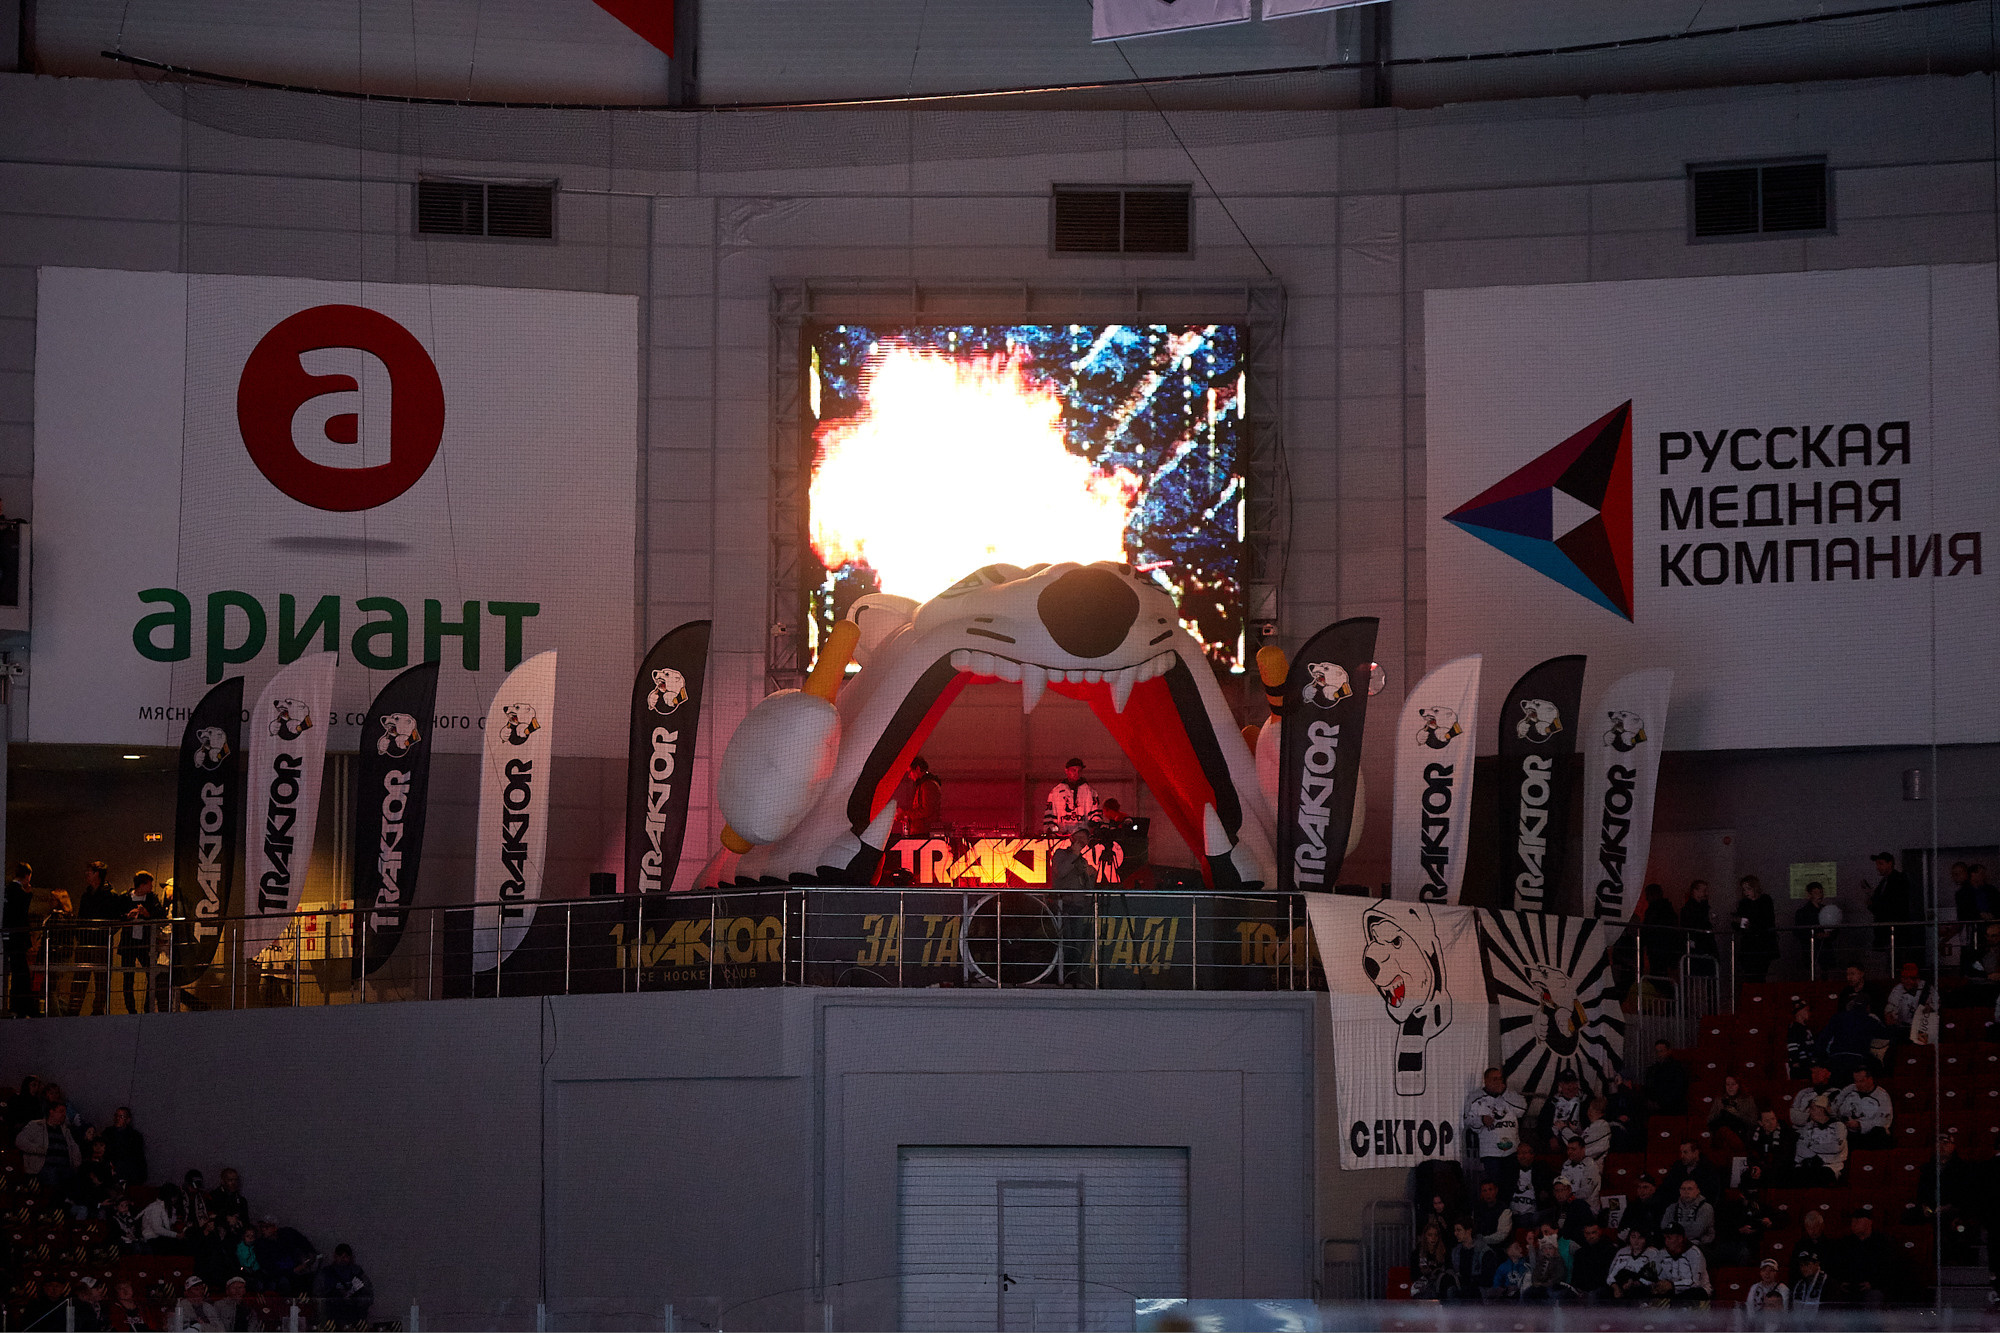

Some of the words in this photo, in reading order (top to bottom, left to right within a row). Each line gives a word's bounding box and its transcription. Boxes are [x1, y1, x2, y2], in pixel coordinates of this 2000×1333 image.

[1660, 421, 1911, 475] РУССКАЯ
[1660, 478, 1901, 531] МЕДНАЯ
[132, 588, 541, 685] ариант
[1660, 532, 1983, 587] КОМПАНИЯ
[193, 781, 225, 944] TRAKTOR
[258, 753, 303, 914] TRAKTOR
[369, 769, 412, 935] TRAKTOR
[499, 758, 533, 925] TRAKTOR
[639, 726, 679, 893] TRAKTOR
[1293, 720, 1341, 889] TRAKTOR
[1419, 762, 1454, 905] RAKTOR
[1513, 754, 1553, 912] TRAKTOR
[1594, 764, 1637, 919] TRAKTOR
[664, 969, 712, 983] HOCKE
[1350, 1119, 1454, 1158] СЕКТОР
